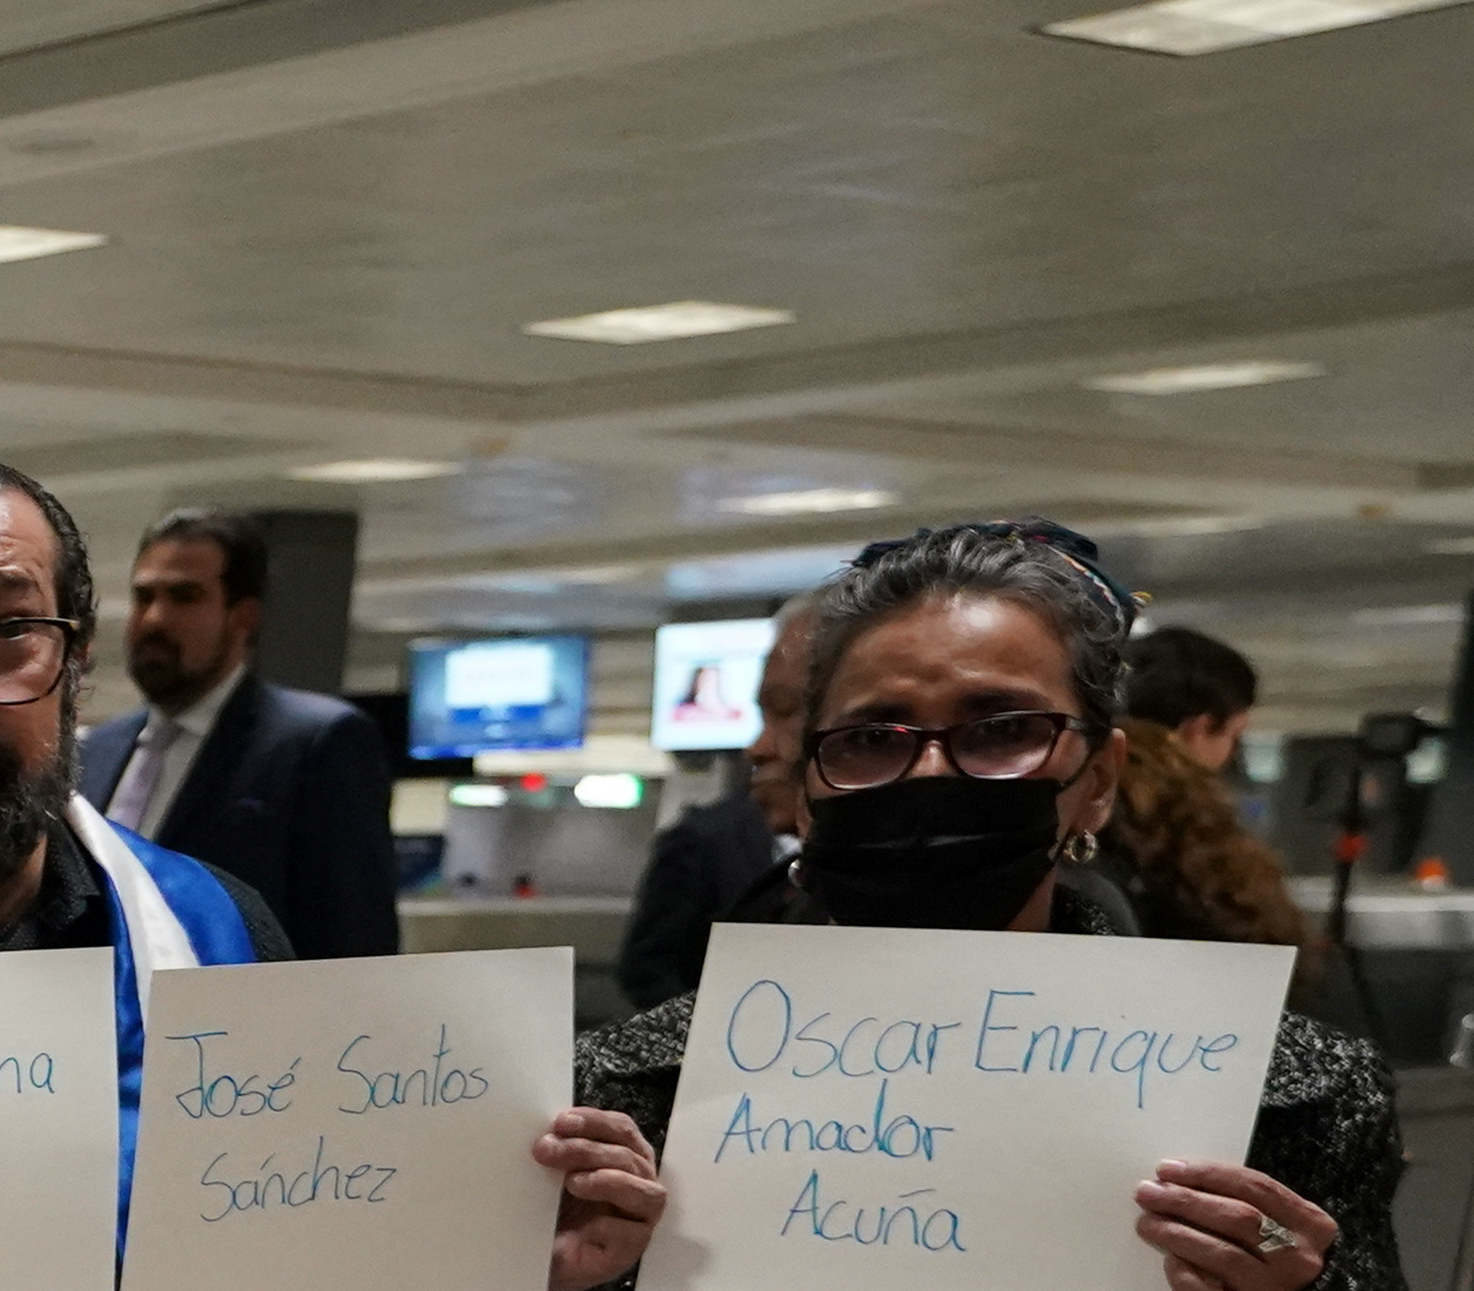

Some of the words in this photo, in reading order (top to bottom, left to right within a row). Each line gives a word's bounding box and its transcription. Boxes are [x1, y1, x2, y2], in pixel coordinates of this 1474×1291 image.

[165, 1031, 303, 1120] José
[337, 1023, 489, 1115] Santos
[727, 979, 962, 1078] Oscar
[974, 988, 1239, 1110] Enrique
[713, 1078, 954, 1163] Amador
[200, 1135, 398, 1222] Sánchez
[781, 1169, 967, 1252] Acuña
